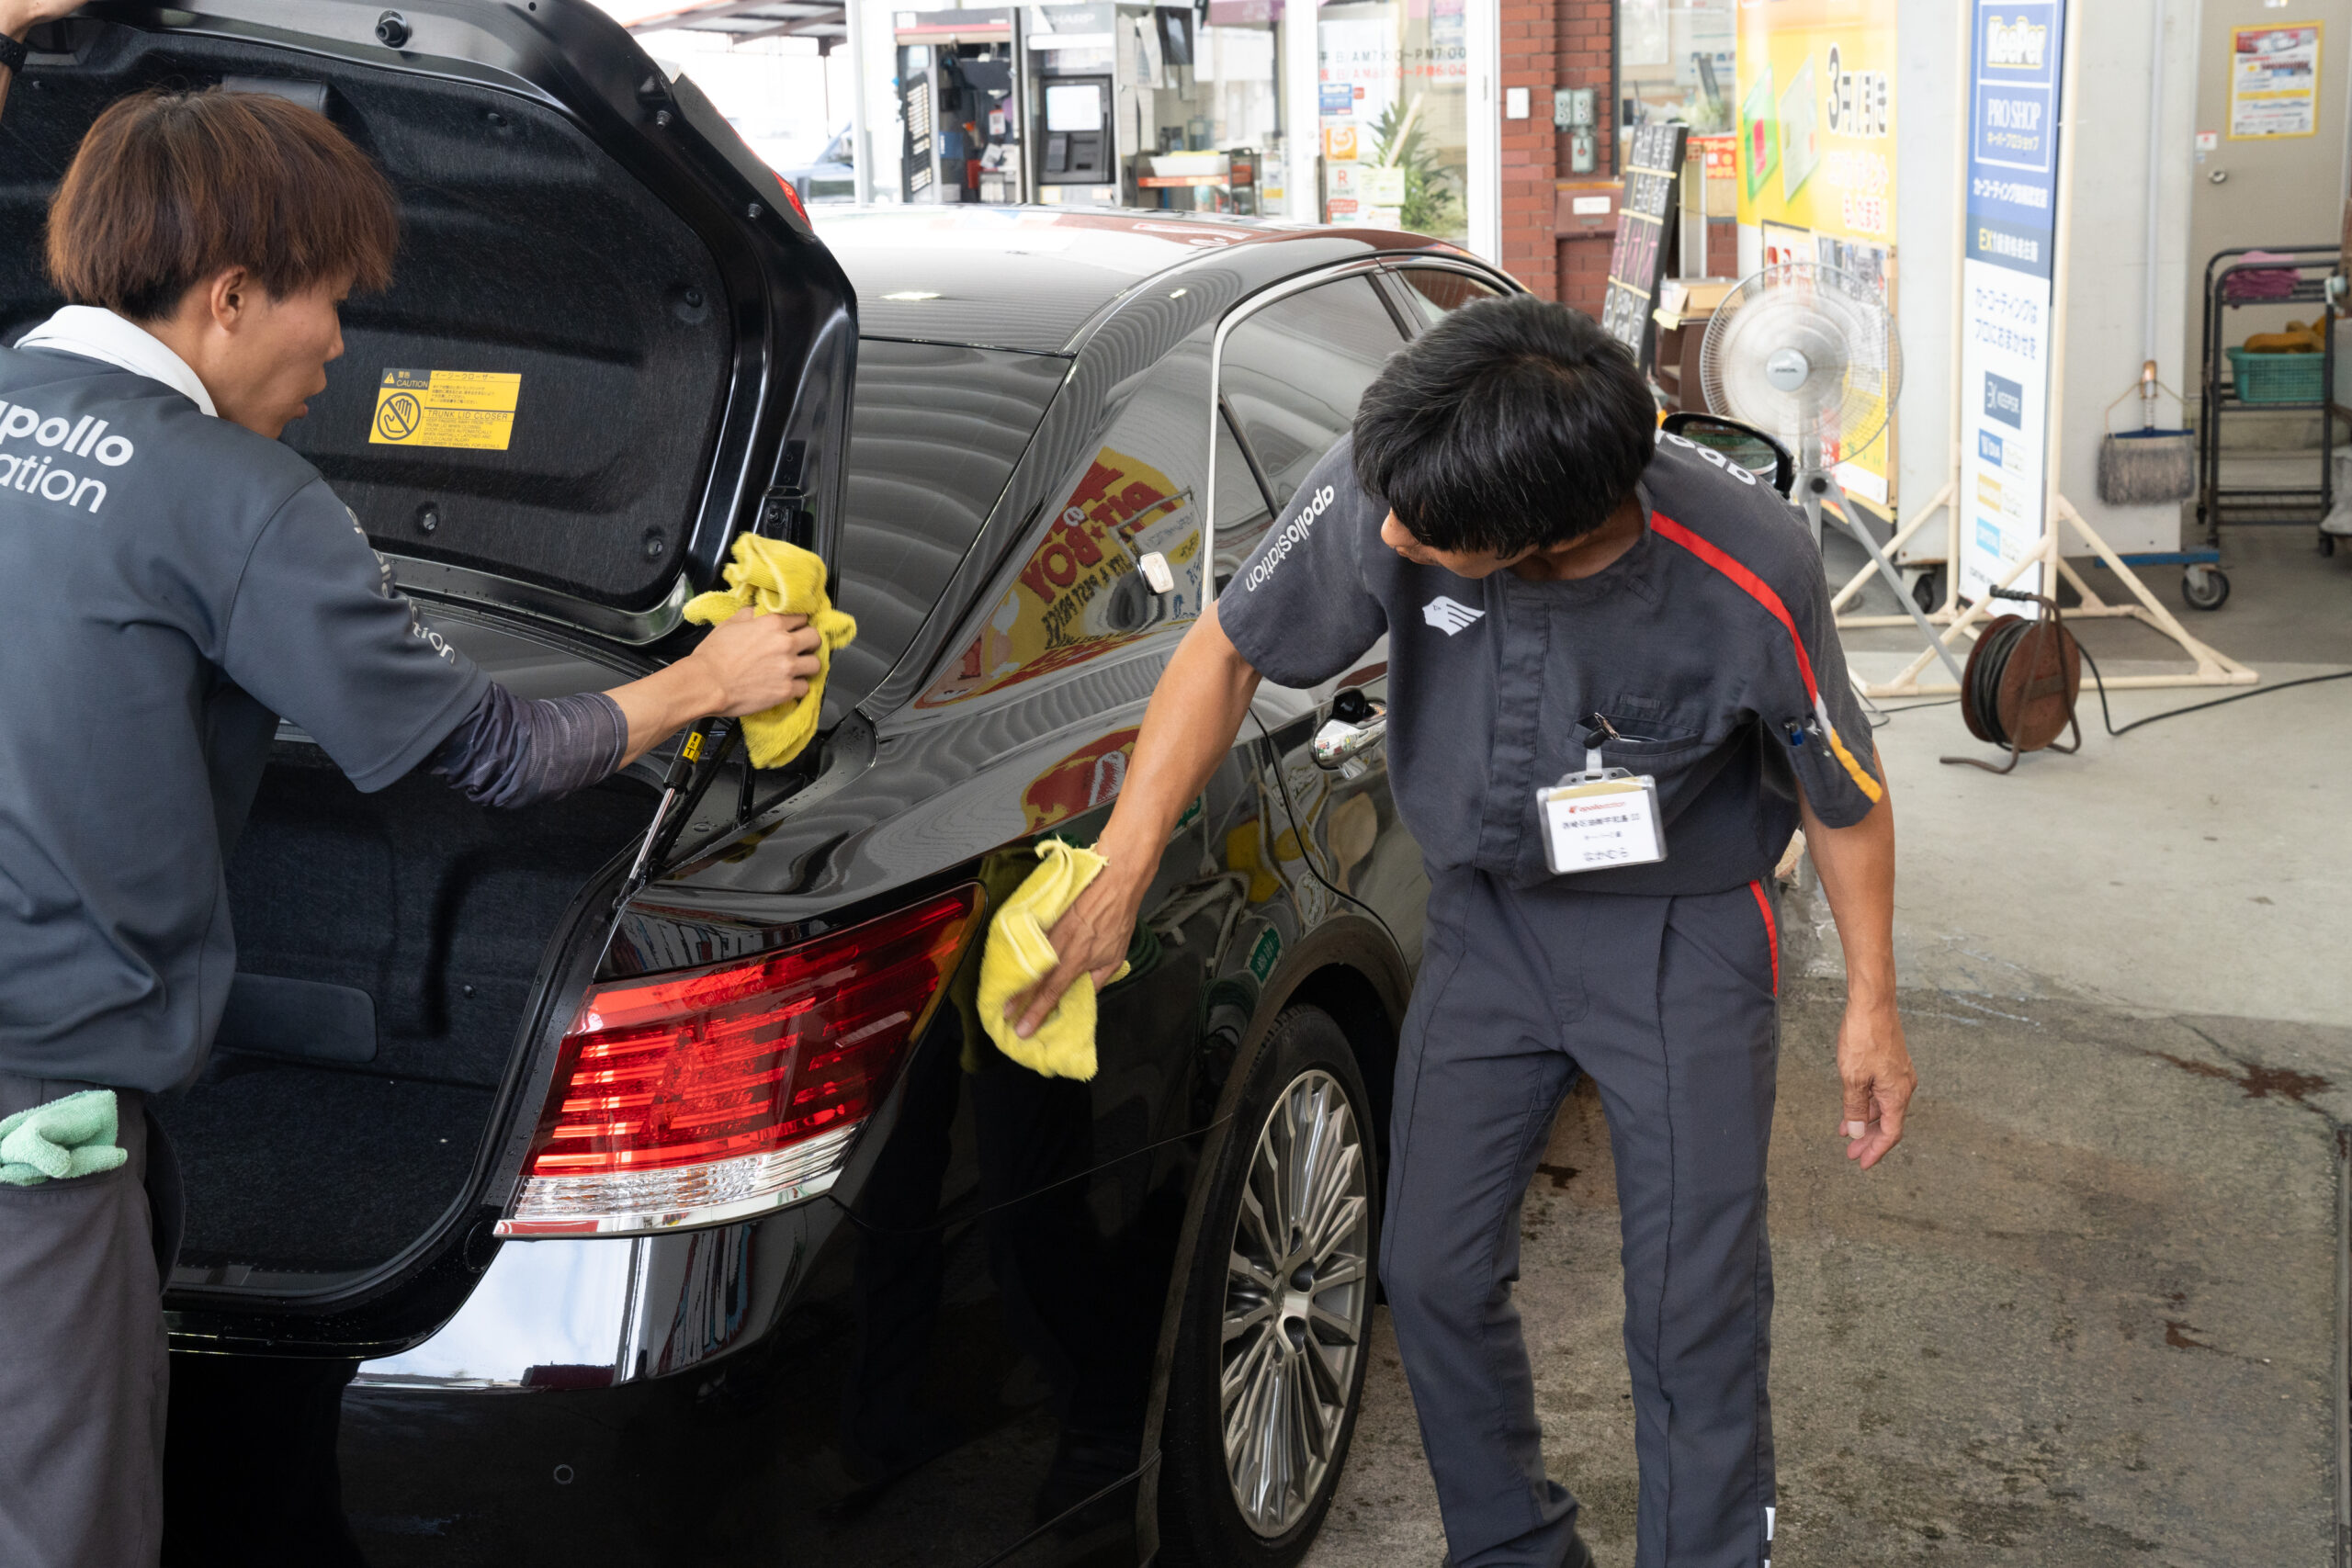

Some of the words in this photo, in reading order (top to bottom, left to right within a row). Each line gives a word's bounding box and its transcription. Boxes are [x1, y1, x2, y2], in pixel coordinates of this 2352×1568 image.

[1987, 97, 2010, 128] PRO
[2011, 99, 2041, 130] SHOP
[435, 372, 496, 381] イージークローザー
[396, 379, 428, 388] CAUTION
[427, 410, 455, 418] TRUNK
[473, 412, 508, 421] CLOSER
[1245, 485, 1335, 592] apollostation
